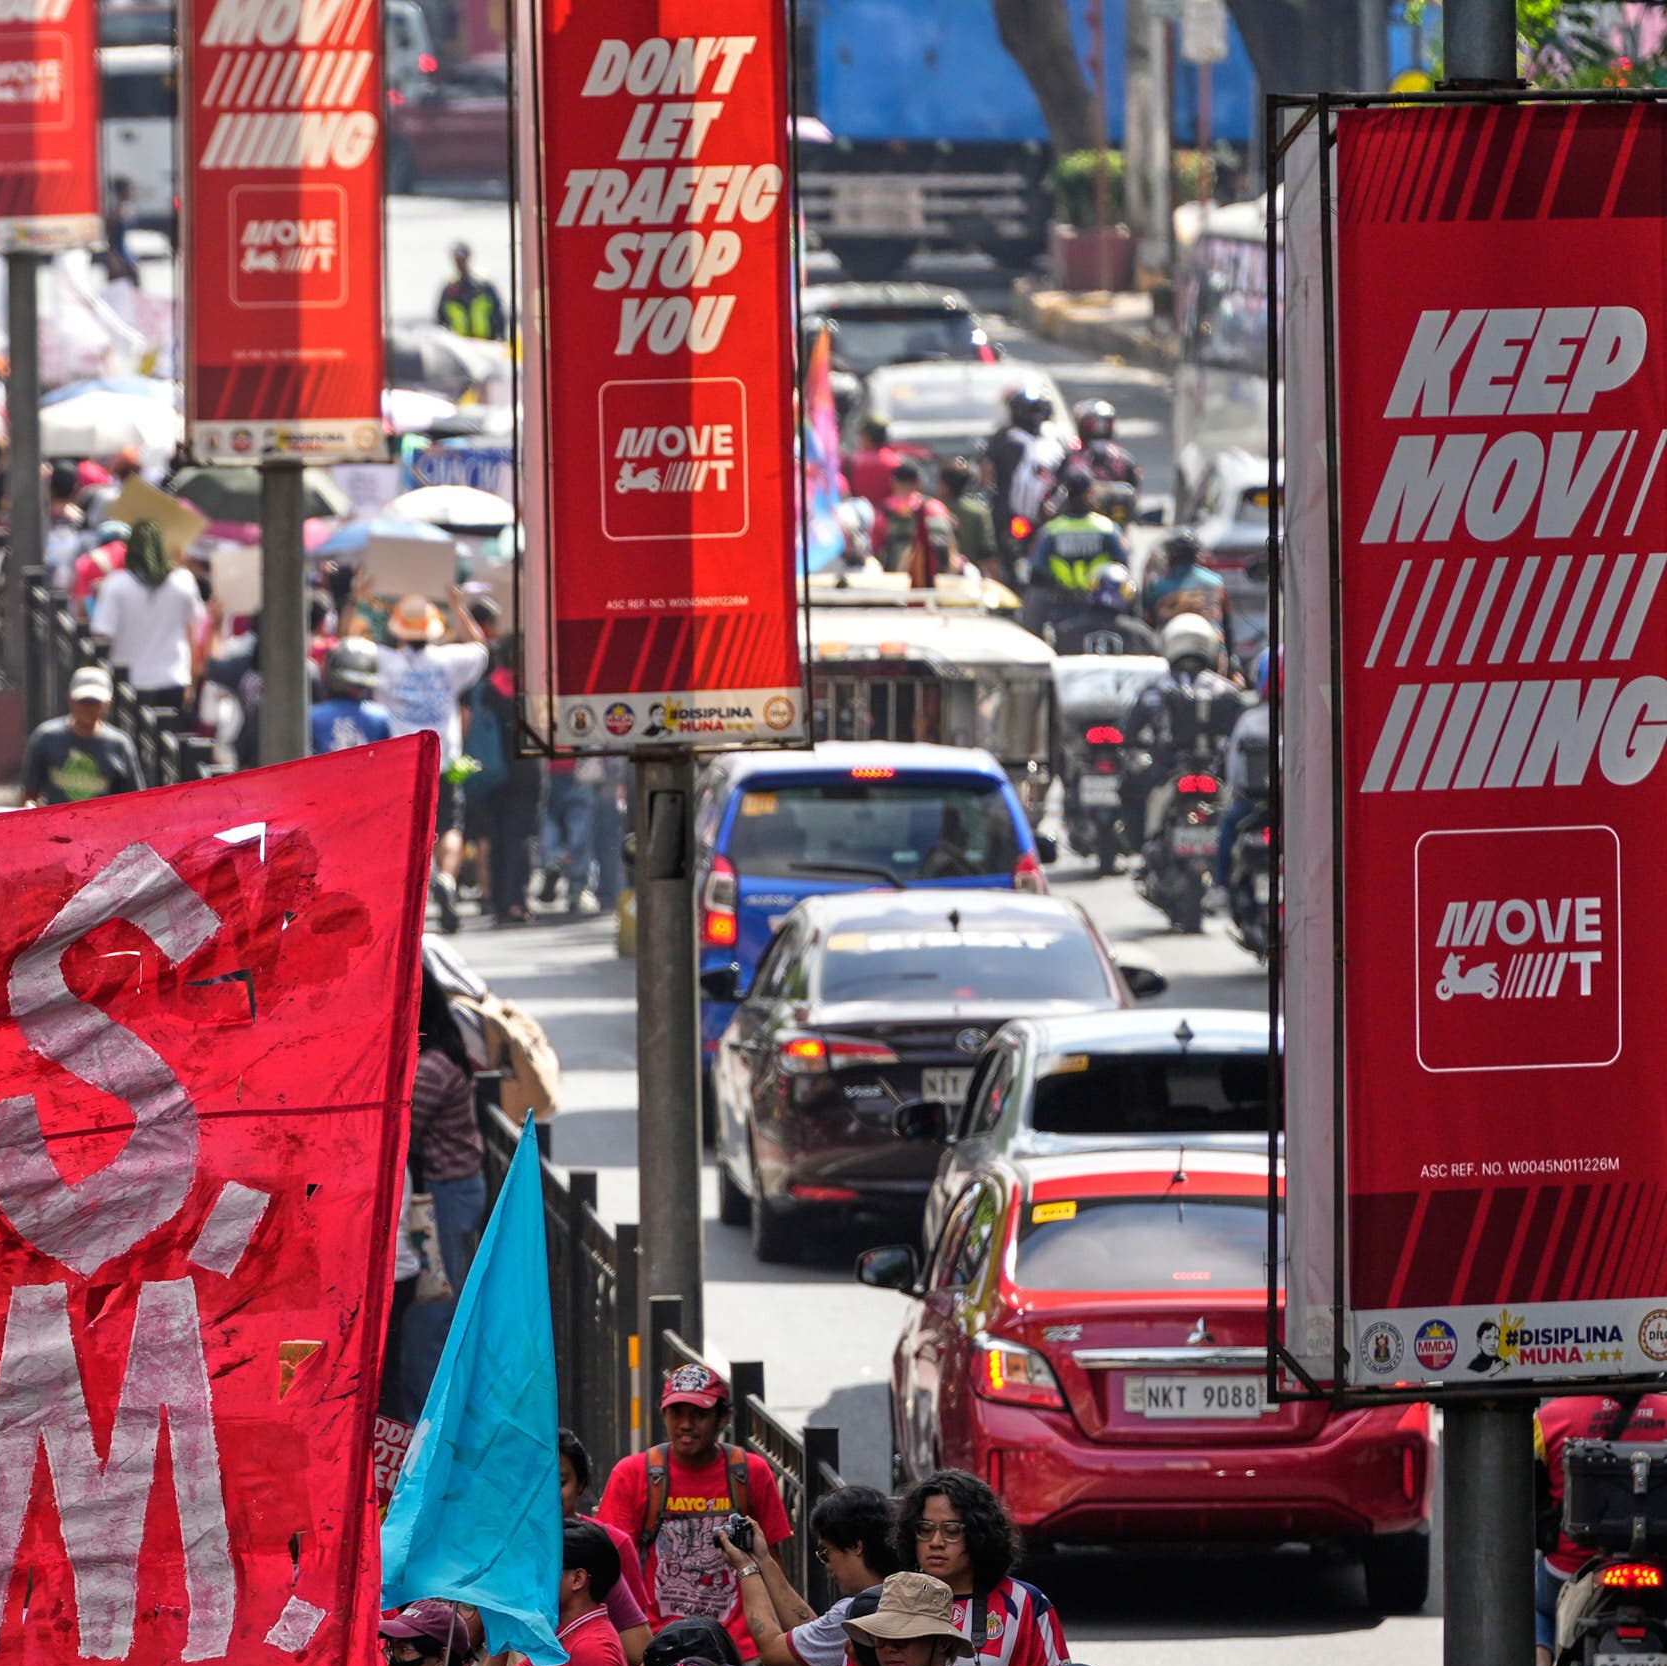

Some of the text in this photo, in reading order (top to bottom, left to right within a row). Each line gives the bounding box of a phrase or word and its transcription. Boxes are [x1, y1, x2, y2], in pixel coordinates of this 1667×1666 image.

[581, 36, 757, 96] DON'T
[616, 101, 724, 160] LET
[555, 163, 784, 227] TRAFFIC
[241, 220, 336, 246] MOVE
[593, 230, 742, 291] STOP
[614, 295, 737, 356] YOU
[1383, 305, 1648, 419] KEEP
[615, 424, 734, 457] MOVE
[1436, 897, 1603, 948] MOVE
[1420, 1157, 1620, 1178] ASC REF. NO. W0045N011226M
[1418, 1341, 1454, 1353] MMDA
[1505, 1324, 1623, 1348] #DISIPLINA
[1519, 1346, 1583, 1366] MUNA
[1145, 1381, 1259, 1413] NKT 9088
